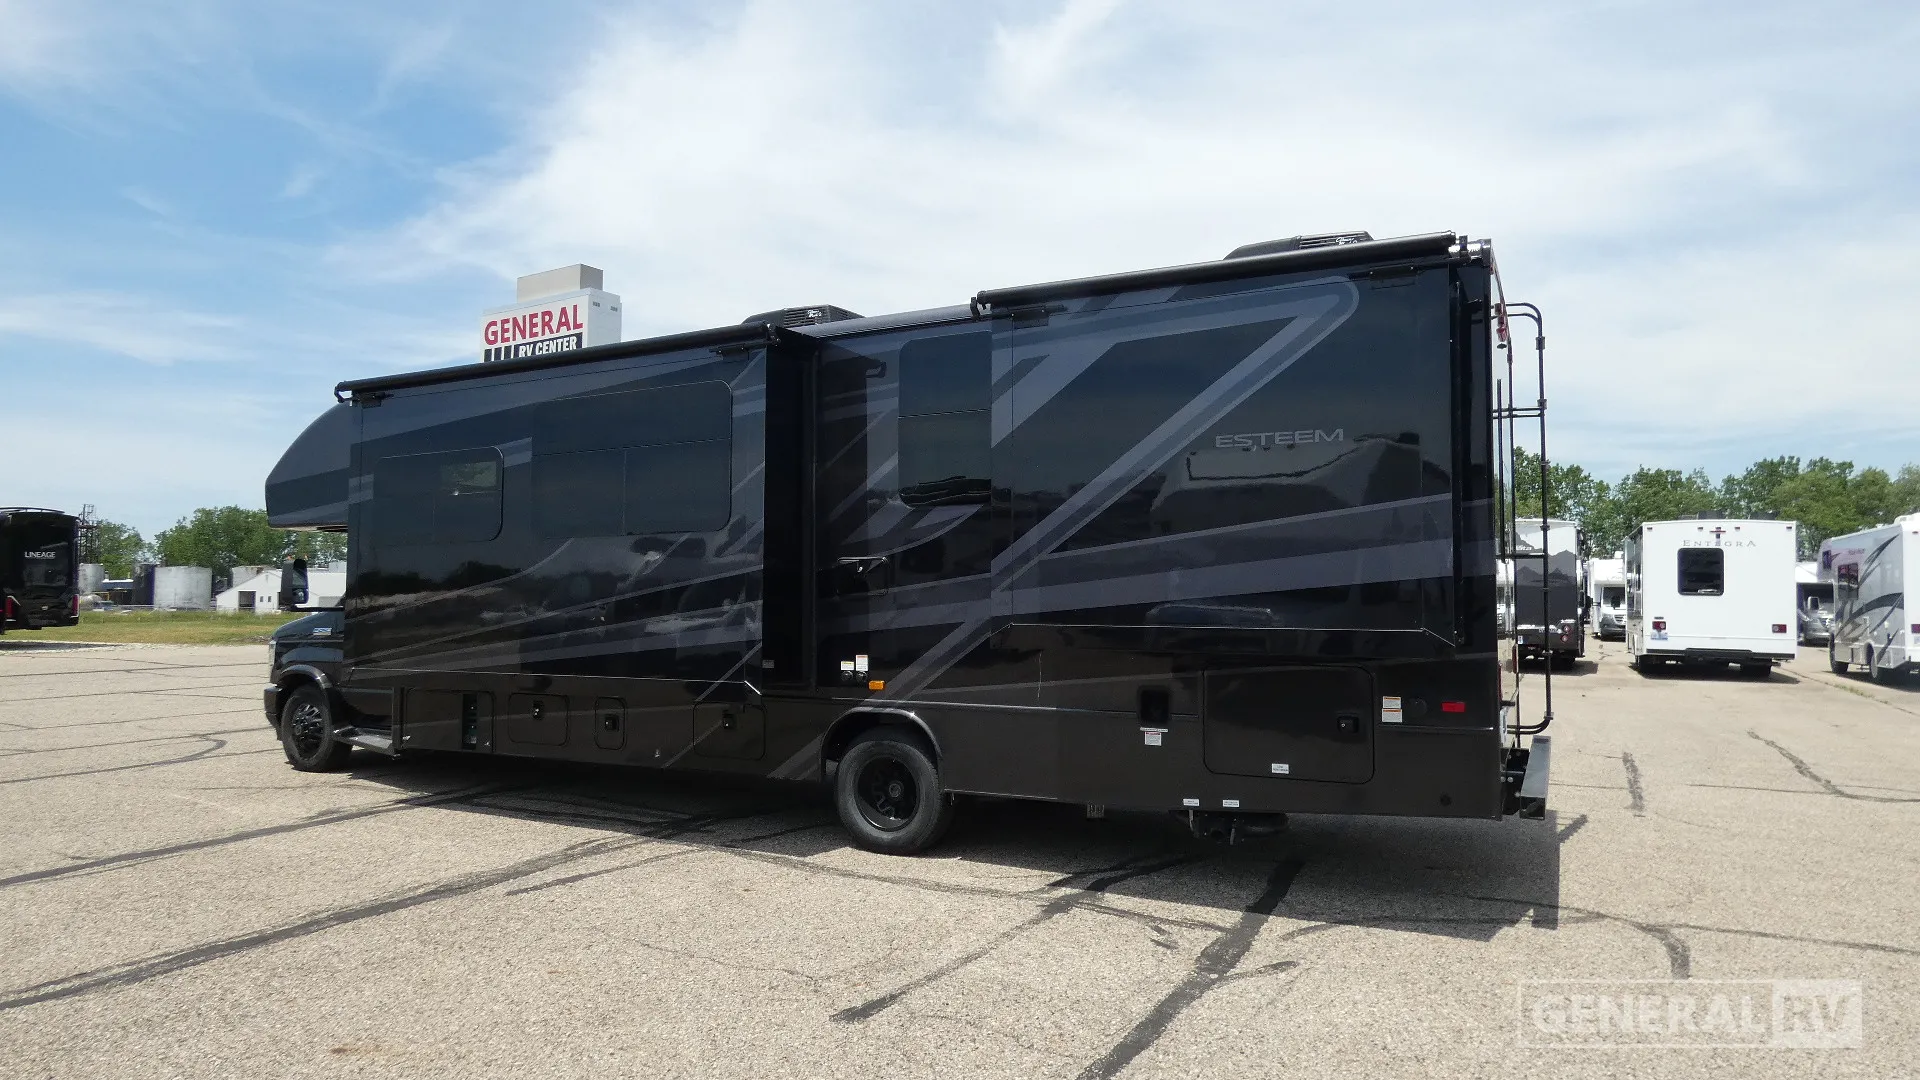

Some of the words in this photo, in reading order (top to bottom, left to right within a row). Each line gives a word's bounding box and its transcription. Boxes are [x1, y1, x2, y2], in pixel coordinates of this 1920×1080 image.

[484, 304, 584, 346] GENERAL
[519, 345, 533, 358] RV
[535, 336, 578, 356] CENTER
[1215, 428, 1344, 448] ESTEEM
[1682, 539, 1757, 547] ENTEGRA
